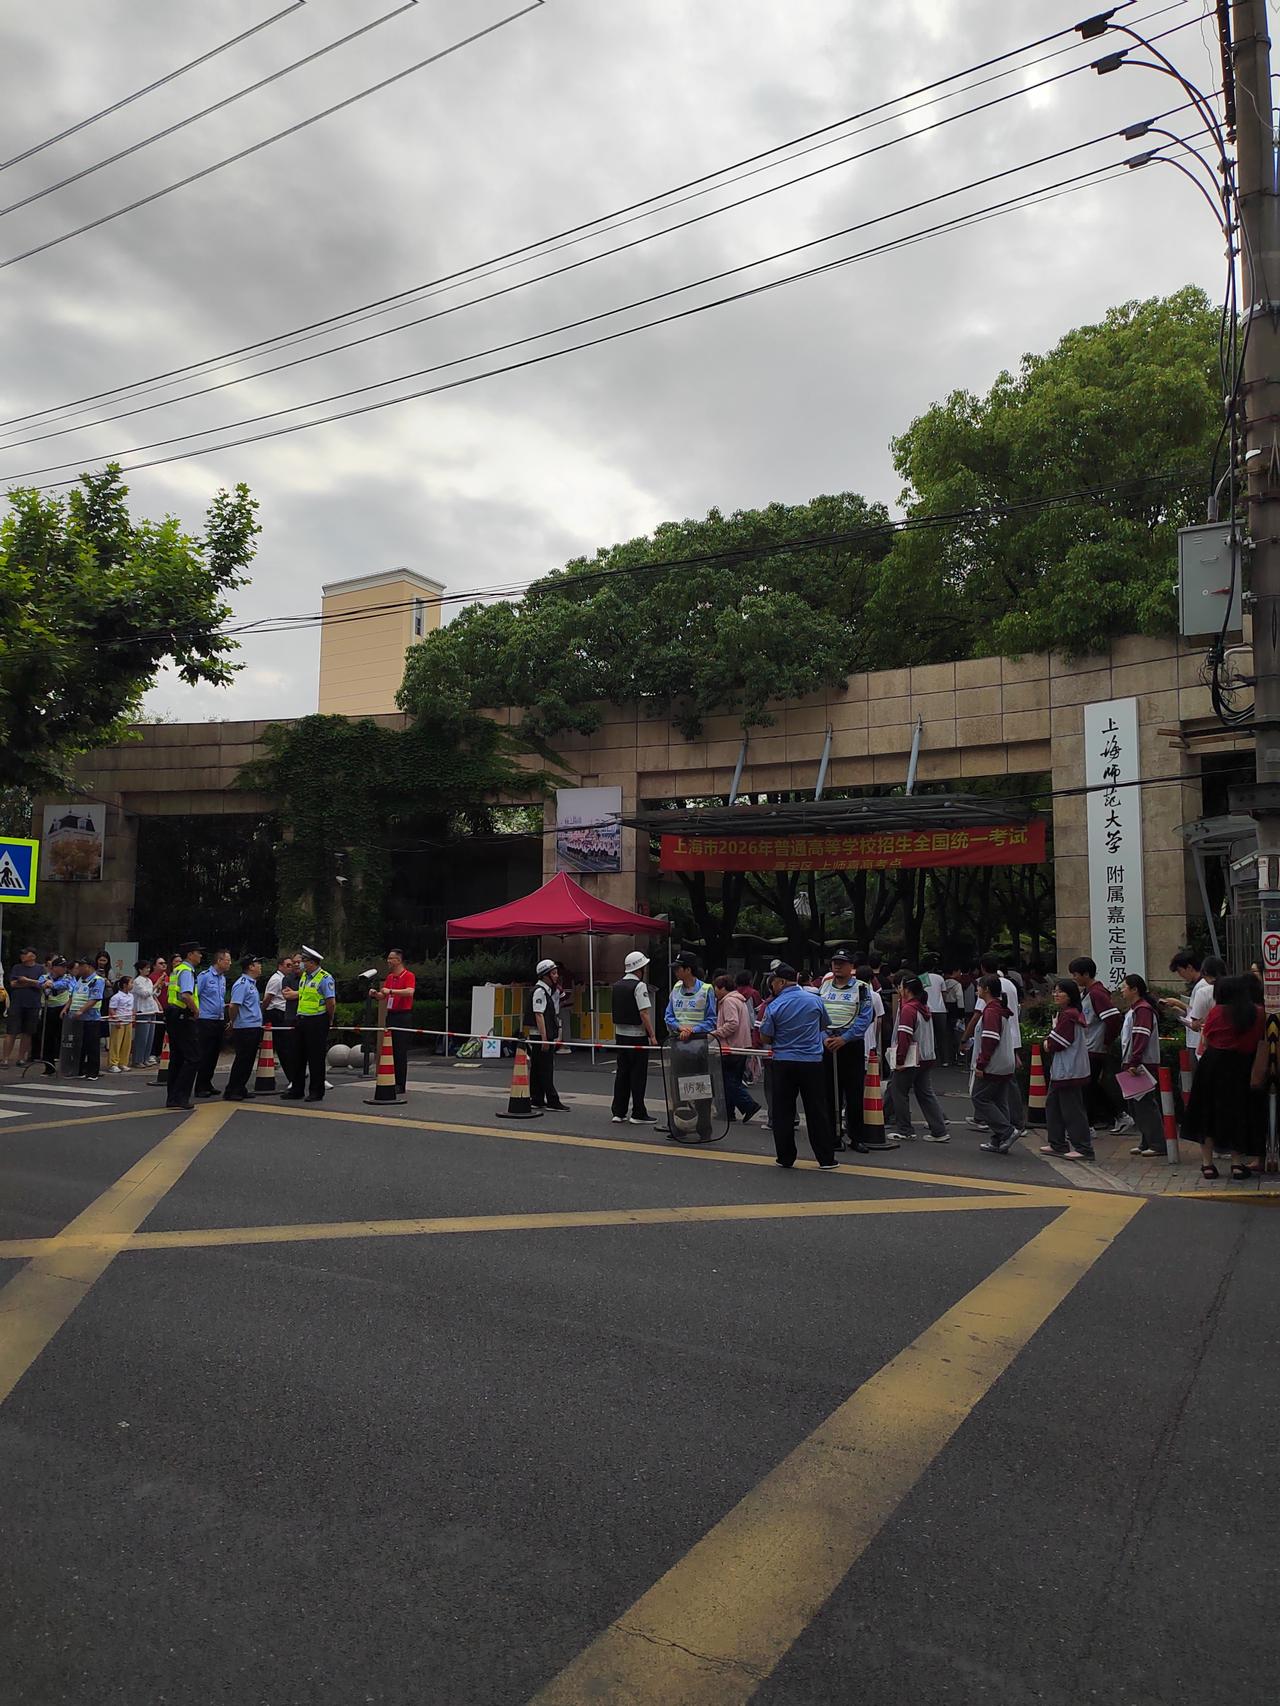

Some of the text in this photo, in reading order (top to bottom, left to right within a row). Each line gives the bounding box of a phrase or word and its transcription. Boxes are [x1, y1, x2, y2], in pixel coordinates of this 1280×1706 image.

[672, 824, 1028, 858] 上海市2026年普通高等学校招生全国统一考试
